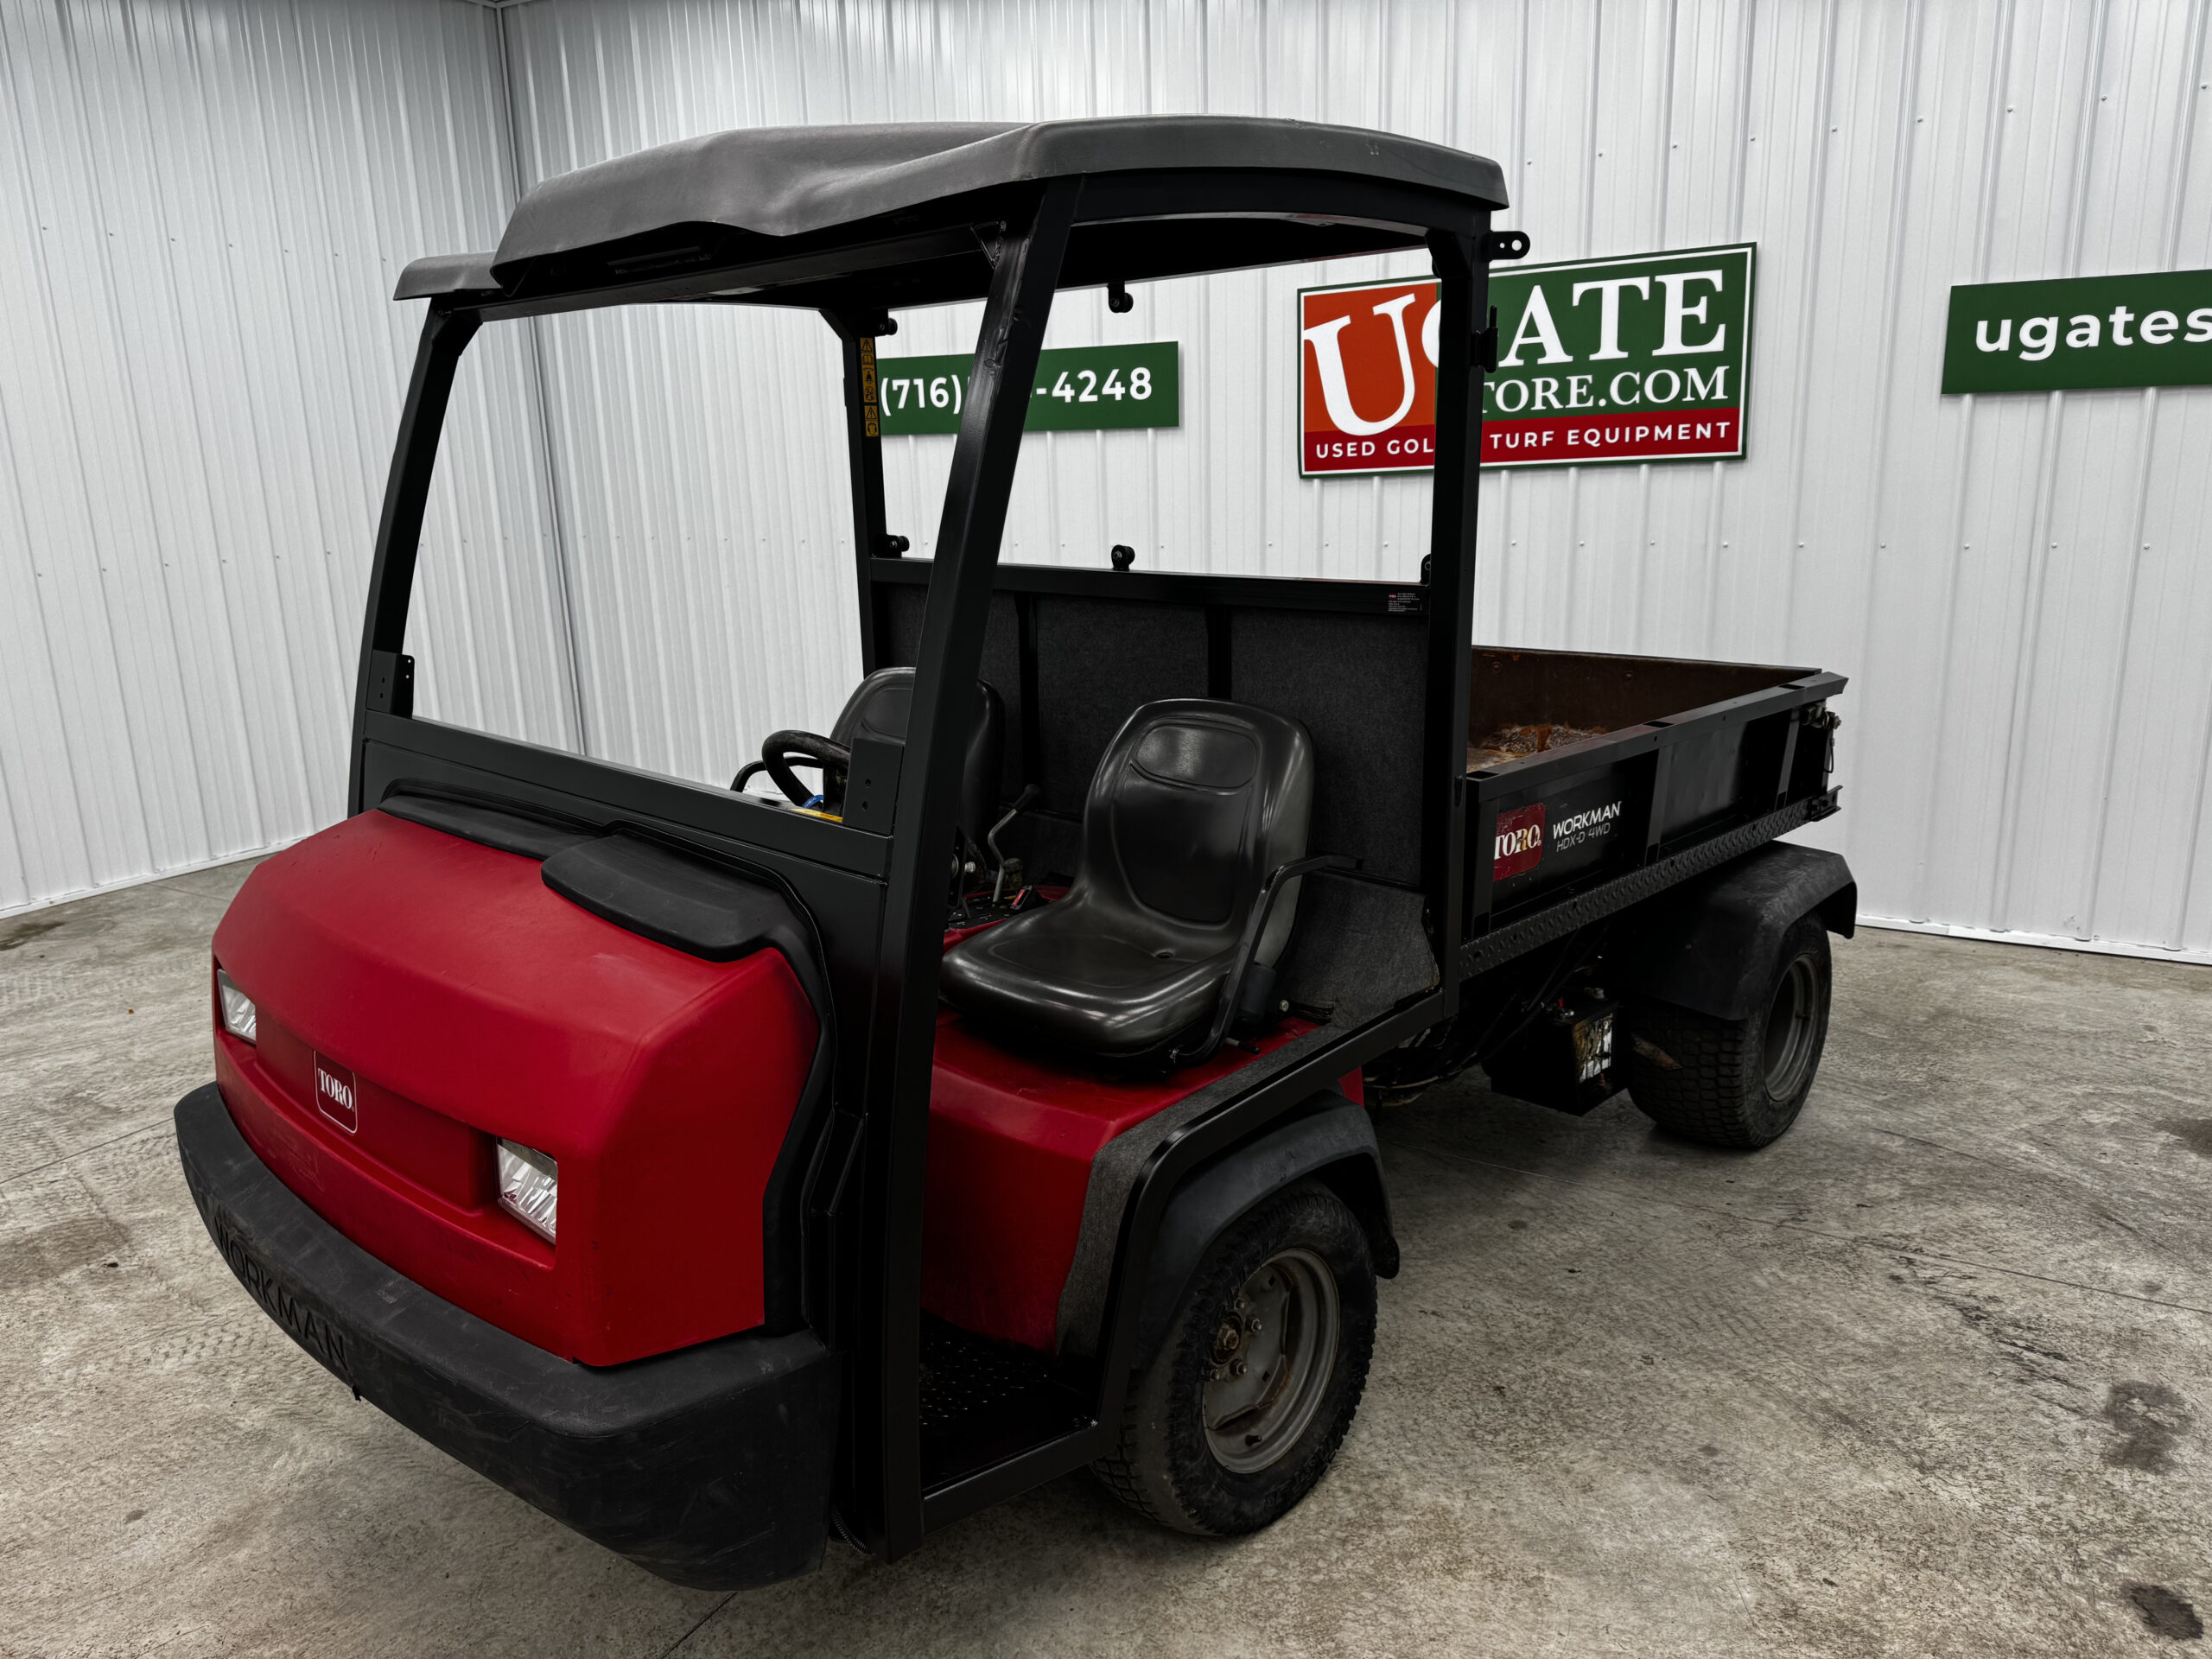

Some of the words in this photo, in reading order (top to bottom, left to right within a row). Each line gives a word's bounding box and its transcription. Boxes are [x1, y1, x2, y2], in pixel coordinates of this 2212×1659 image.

[1303, 269, 1726, 436] UATE
[1975, 305, 2212, 361] ugates
[880, 374, 962, 416] (716)
[968, 366, 1153, 404] -4248
[1316, 441, 1376, 459] USED
[1387, 437, 1434, 455] GOL
[1490, 430, 1555, 449] TURF
[1567, 422, 1731, 448] EQUIPMENT
[1553, 800, 1623, 840] WORKMAN
[1556, 831, 1586, 852] HDX-D
[1588, 822, 1611, 839] 4WD
[317, 1067, 353, 1110] TORO
